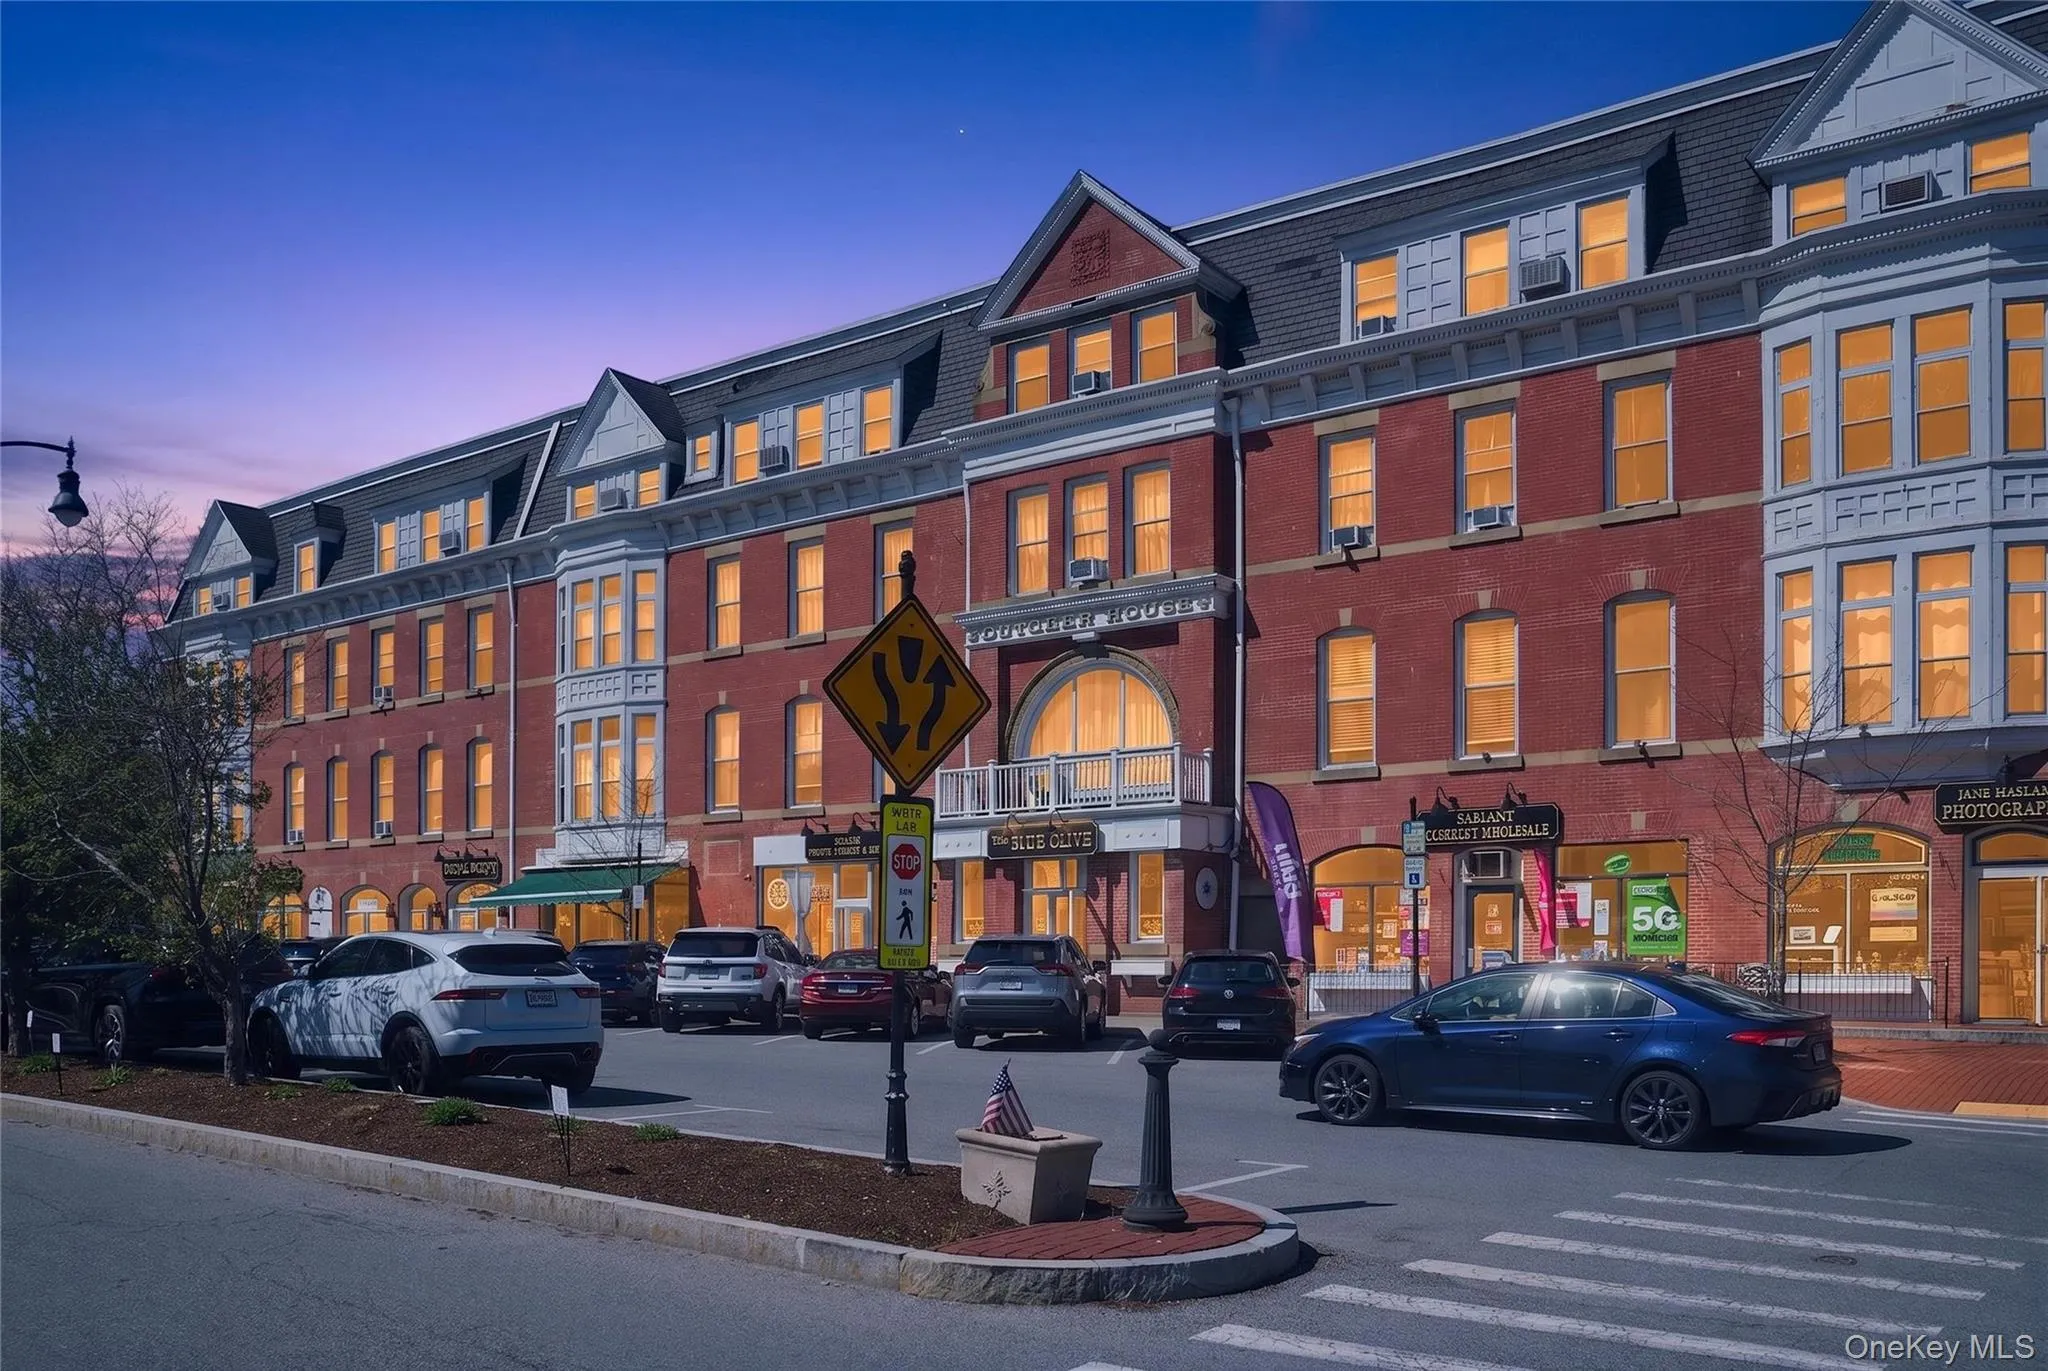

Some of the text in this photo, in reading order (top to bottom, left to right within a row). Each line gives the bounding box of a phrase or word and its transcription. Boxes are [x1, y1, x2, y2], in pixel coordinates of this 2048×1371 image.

[1958, 788, 1991, 801] JANE
[1942, 800, 2048, 820] PHOTOGRAP
[894, 854, 920, 870] STOP
